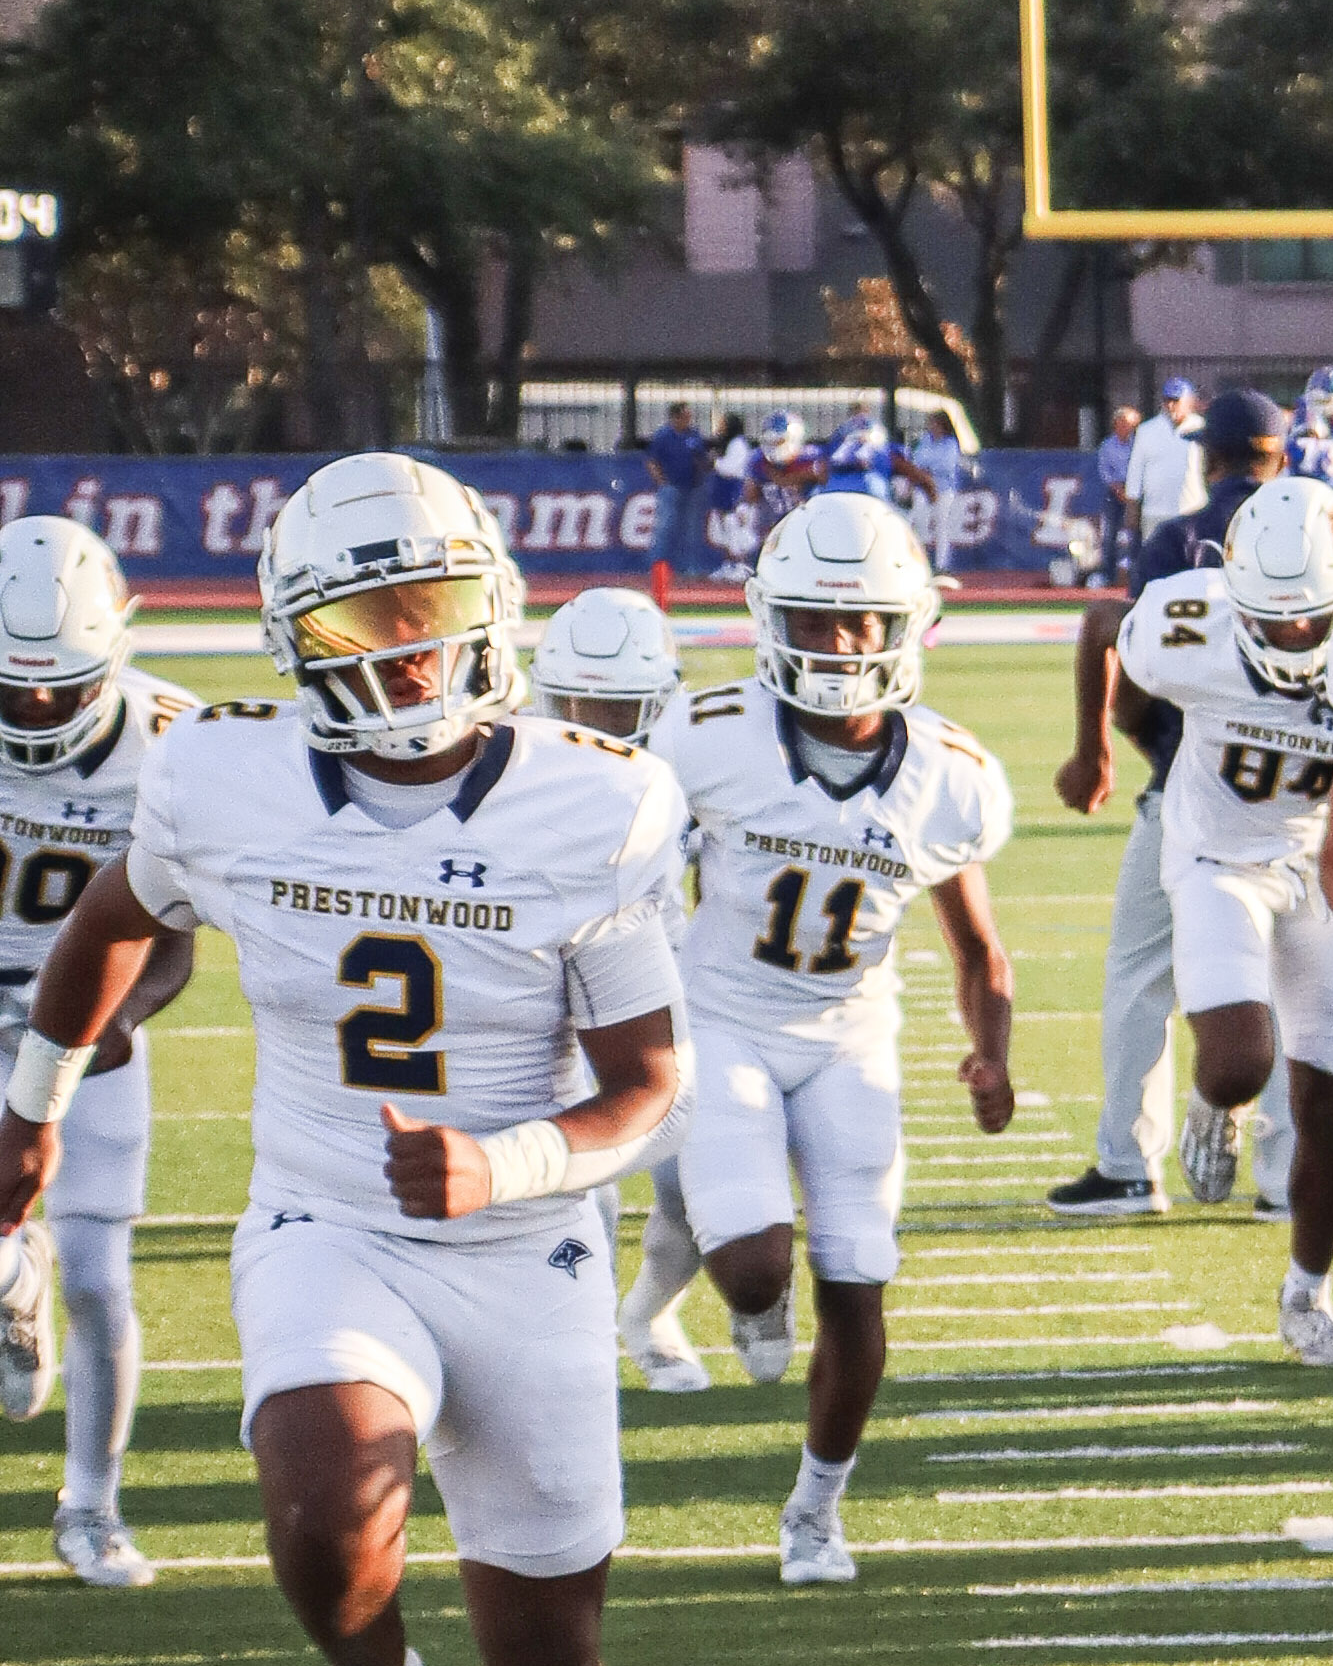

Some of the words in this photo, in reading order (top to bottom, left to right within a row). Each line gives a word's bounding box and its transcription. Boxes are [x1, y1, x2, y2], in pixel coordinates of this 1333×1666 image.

[744, 831, 913, 879] PRESTONWOOD
[270, 880, 514, 932] PRESTONWOOD
[753, 864, 867, 975] 11
[335, 931, 448, 1096] 2
